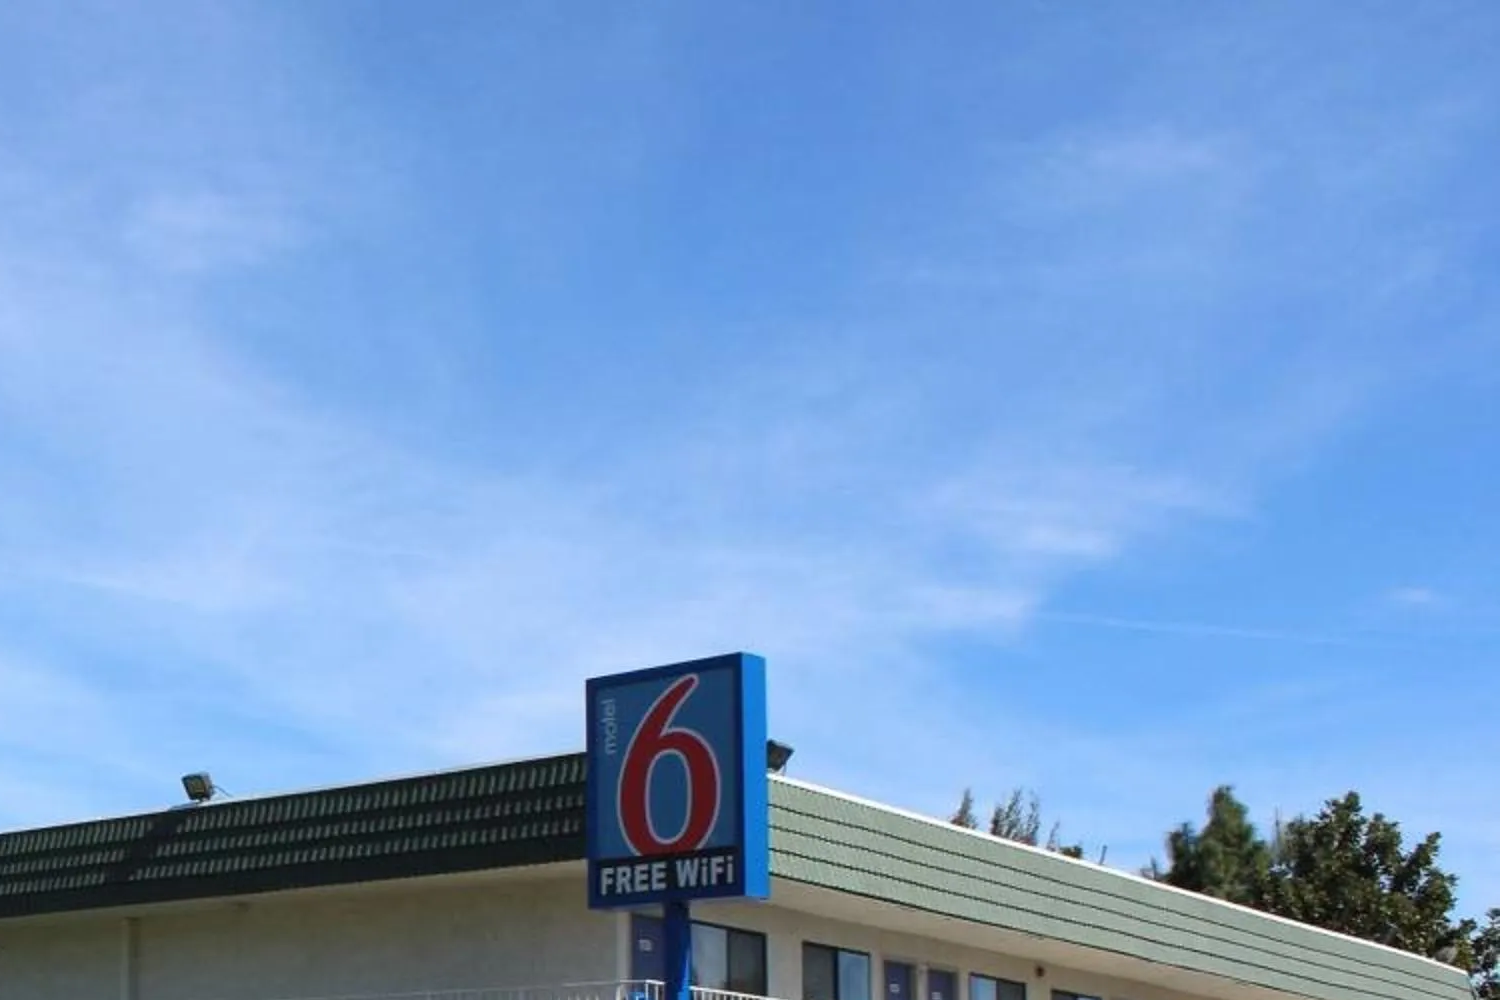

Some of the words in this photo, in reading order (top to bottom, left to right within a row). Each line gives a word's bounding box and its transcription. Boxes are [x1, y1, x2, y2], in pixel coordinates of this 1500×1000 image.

[601, 698, 617, 755] motel
[617, 673, 721, 857] 6
[601, 861, 667, 896] FREE
[676, 855, 734, 888] WiFi
